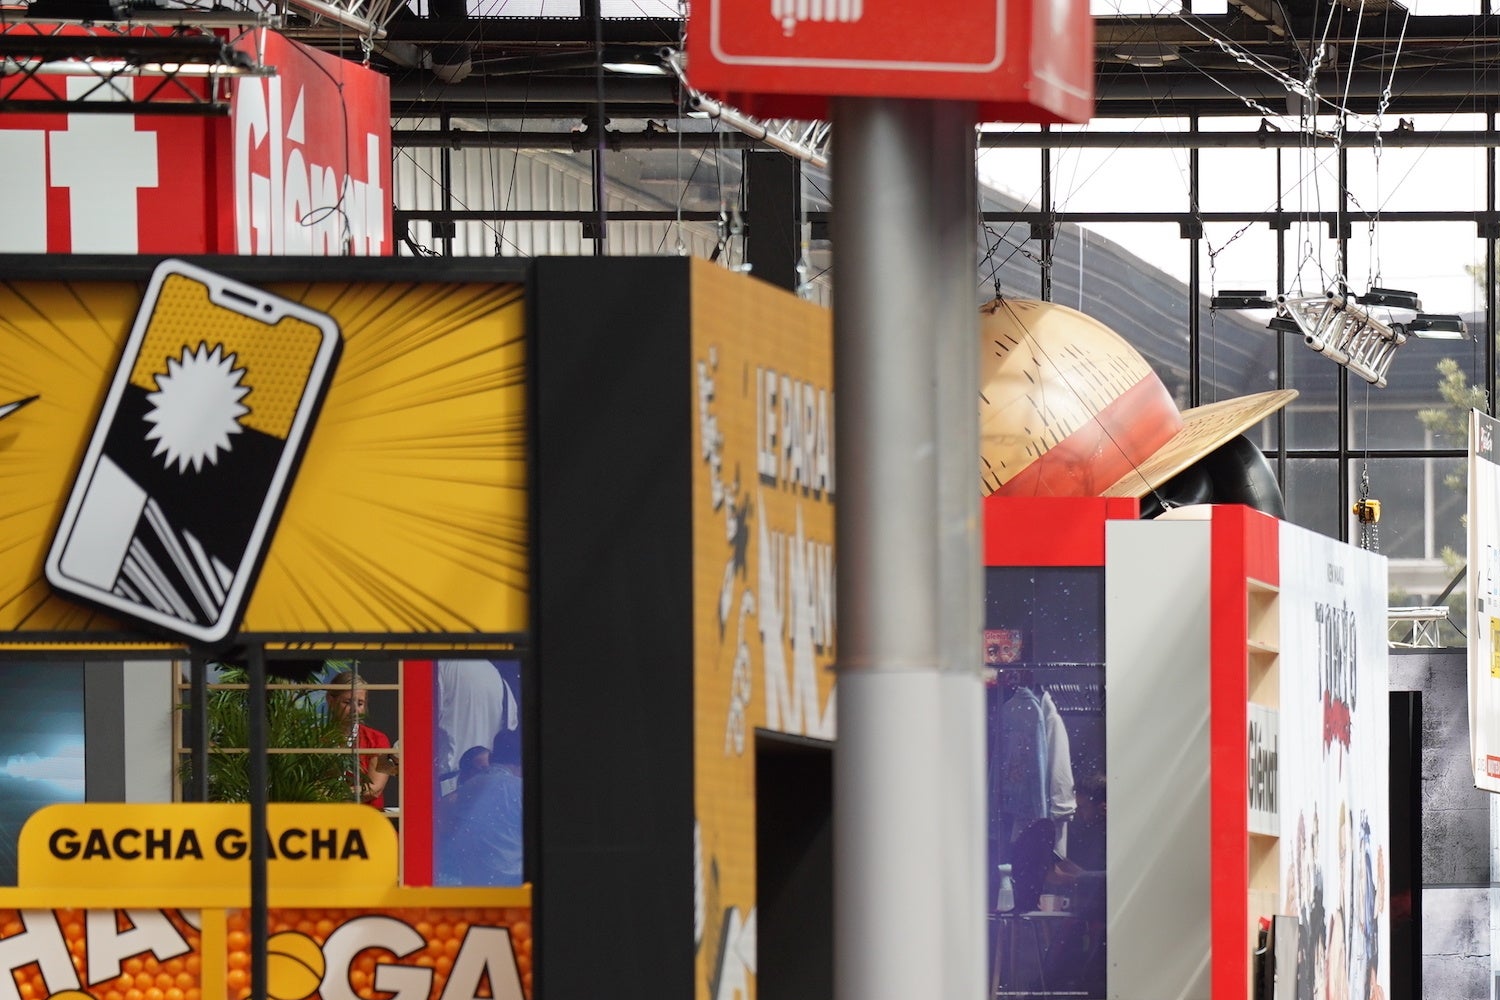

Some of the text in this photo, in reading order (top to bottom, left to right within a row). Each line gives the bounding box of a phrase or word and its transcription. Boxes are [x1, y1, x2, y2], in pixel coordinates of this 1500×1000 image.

[234, 75, 384, 255] Glénat
[780, 375, 836, 503] PARA
[48, 827, 204, 860] GACHA
